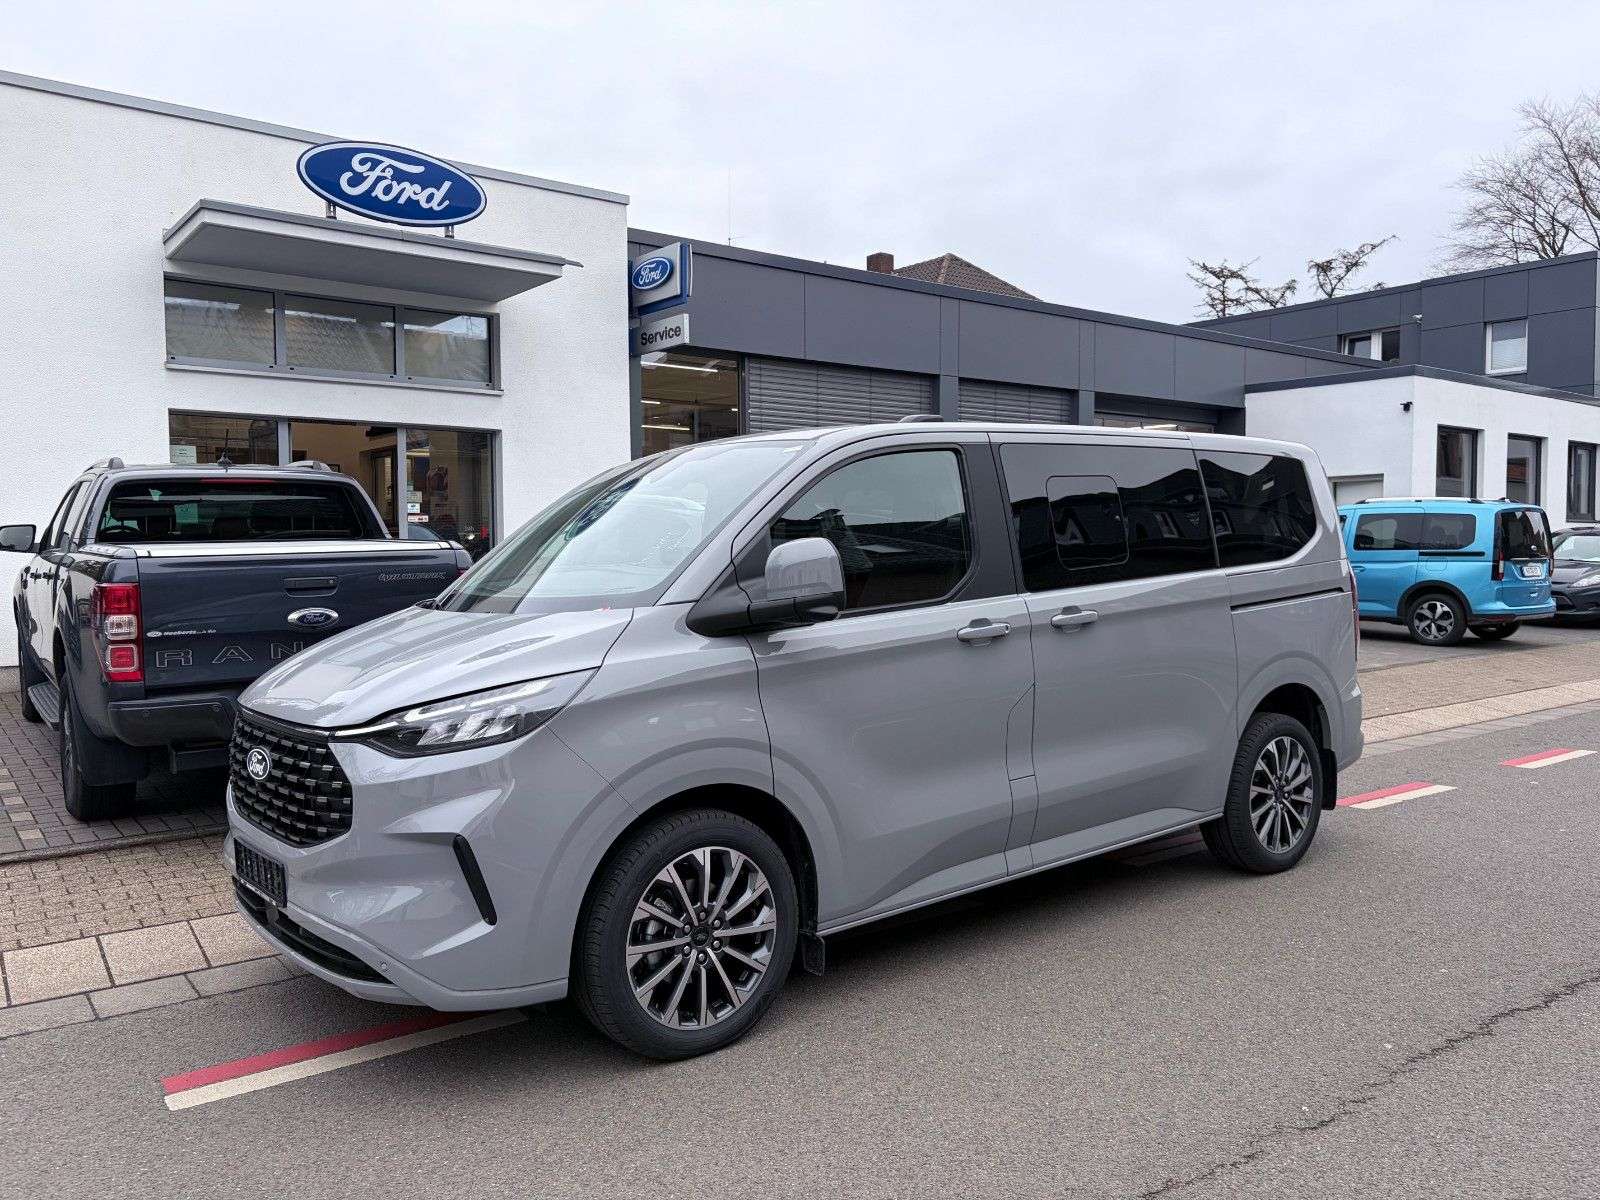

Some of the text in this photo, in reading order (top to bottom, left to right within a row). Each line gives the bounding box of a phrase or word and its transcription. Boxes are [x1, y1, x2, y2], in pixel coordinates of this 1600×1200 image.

[339, 152, 452, 211] Ford
[638, 262, 663, 285] Ford
[640, 325, 682, 346] Service
[304, 613, 326, 623] Ford
[250, 752, 266, 776] Ford
